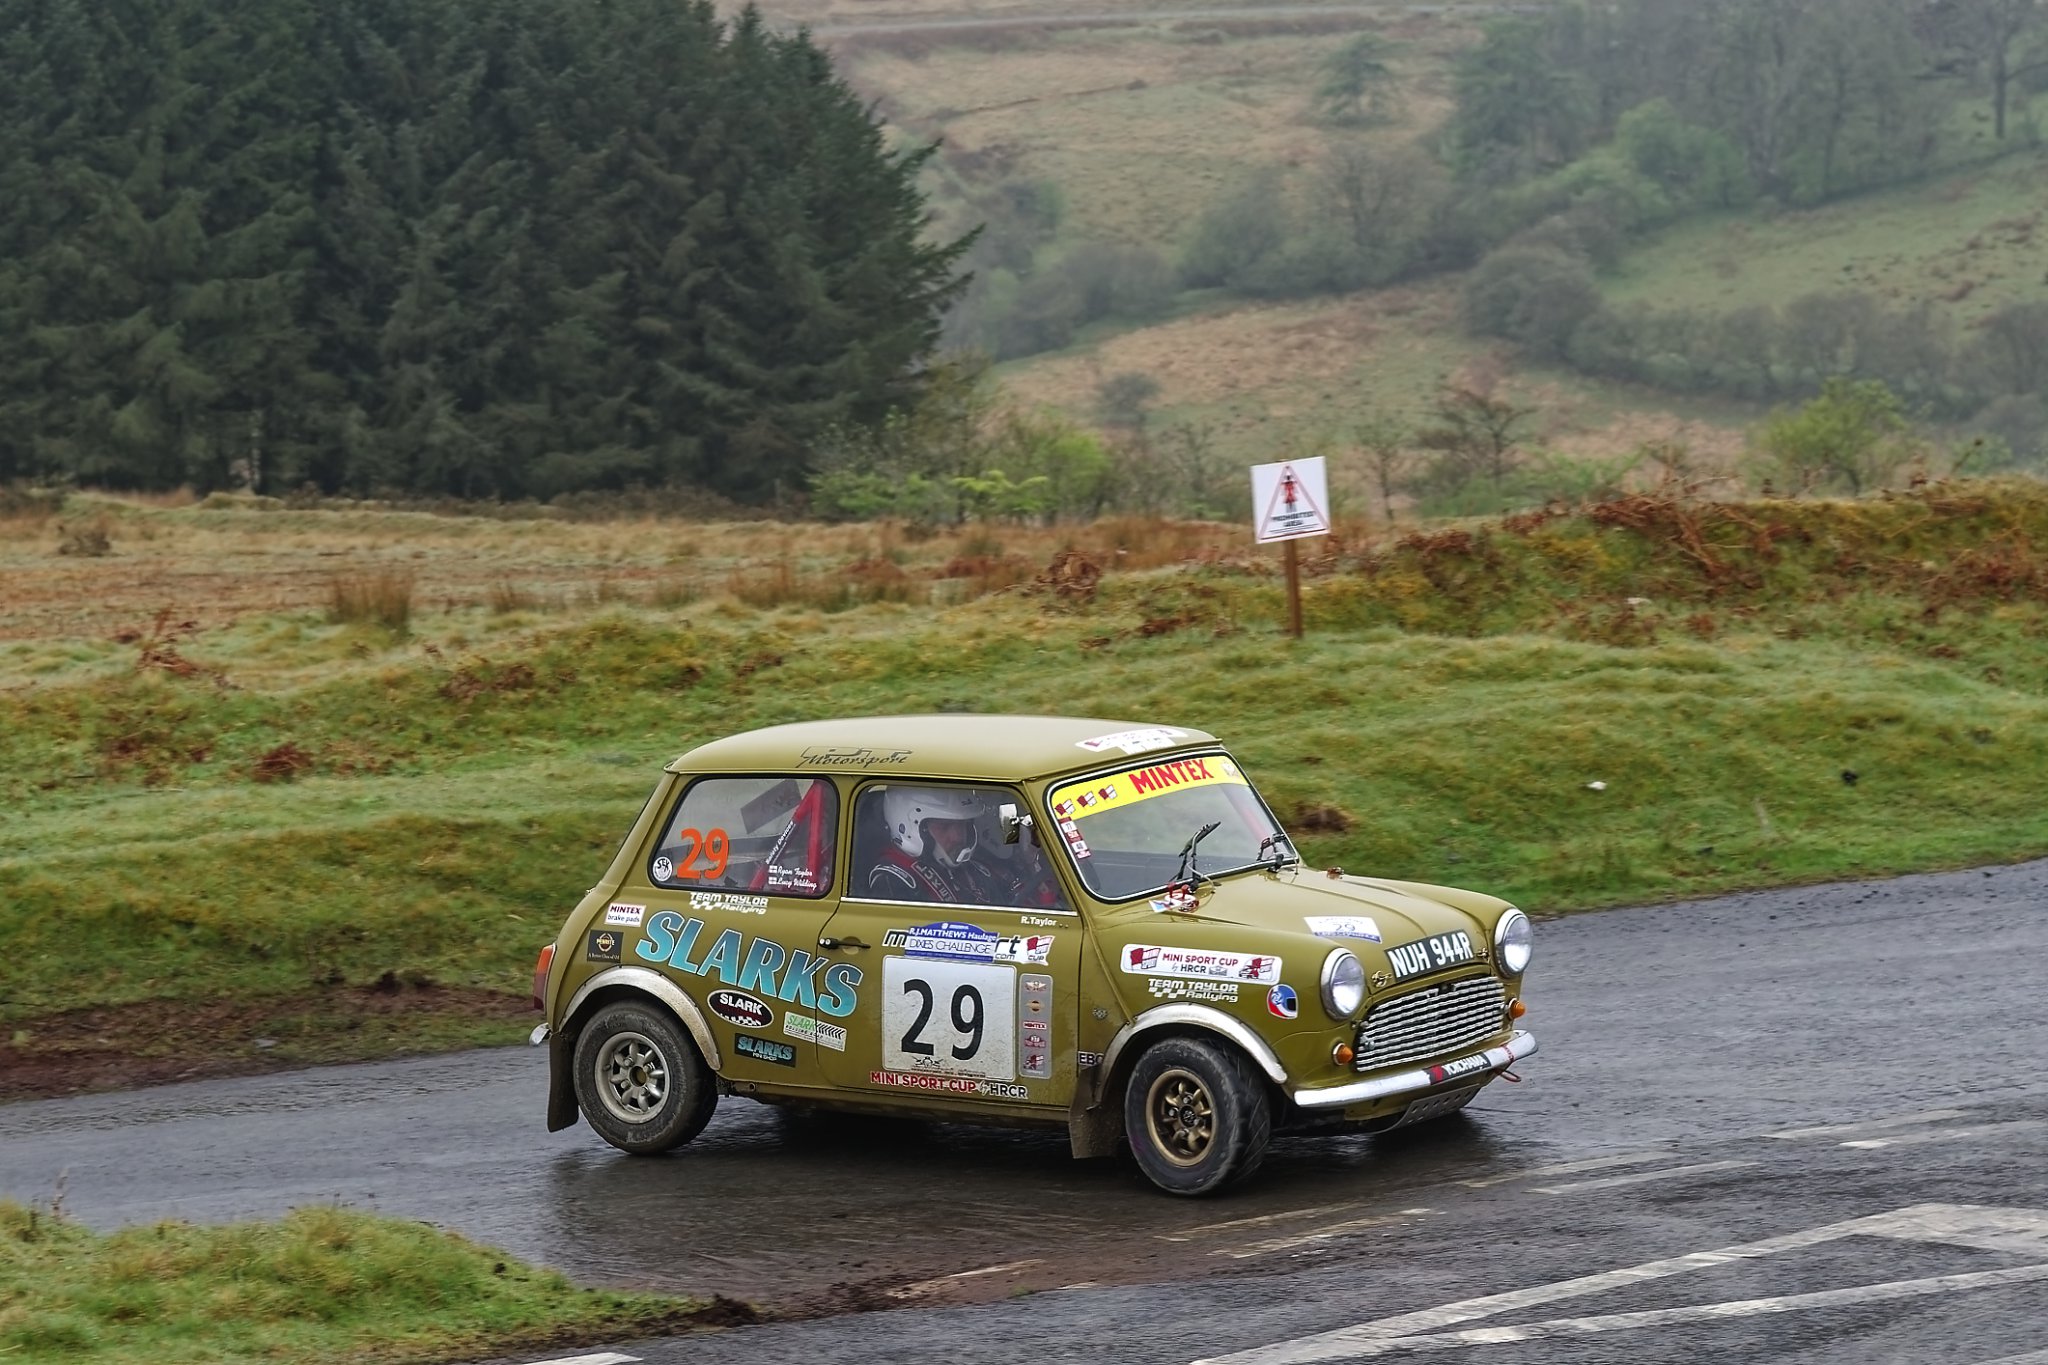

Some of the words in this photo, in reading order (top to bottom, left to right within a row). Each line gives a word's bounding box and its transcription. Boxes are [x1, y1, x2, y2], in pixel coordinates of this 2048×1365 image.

[795, 753, 908, 768] Motorsport
[1129, 759, 1214, 794] MINTEX
[676, 828, 729, 880] 29
[778, 865, 793, 876] Ryan
[794, 867, 813, 878] Taylor
[690, 892, 722, 902] TEAM
[723, 894, 769, 906] TAYLOR
[610, 905, 641, 915] MINTEX
[720, 902, 767, 915] Rallying
[607, 914, 625, 922] brake
[625, 915, 640, 924] pads
[1021, 916, 1057, 927] R.Taylor
[1332, 923, 1356, 933] 29
[967, 932, 997, 943] Haulage
[935, 940, 991, 954] CHALLENGE
[1162, 953, 1183, 962] MINI
[1185, 955, 1215, 965] SPORT
[1218, 958, 1239, 967] CUP
[1387, 941, 1431, 978] NUH
[1430, 932, 1473, 965] 944R
[635, 911, 864, 1017] SLARKS
[1180, 964, 1206, 973] HRCR
[1148, 978, 1184, 989] TEAM
[1187, 980, 1239, 993] TAYLOR
[719, 993, 762, 1015] SLARK
[1186, 991, 1238, 1003] Rallying
[786, 1015, 816, 1031] SLARK
[901, 979, 984, 1061] 29
[737, 1036, 793, 1060] SLARKS
[870, 1072, 899, 1085] MINI
[901, 1074, 945, 1090] SPORT
[949, 1079, 976, 1093] CUP
[990, 1083, 1028, 1099] HRCR
